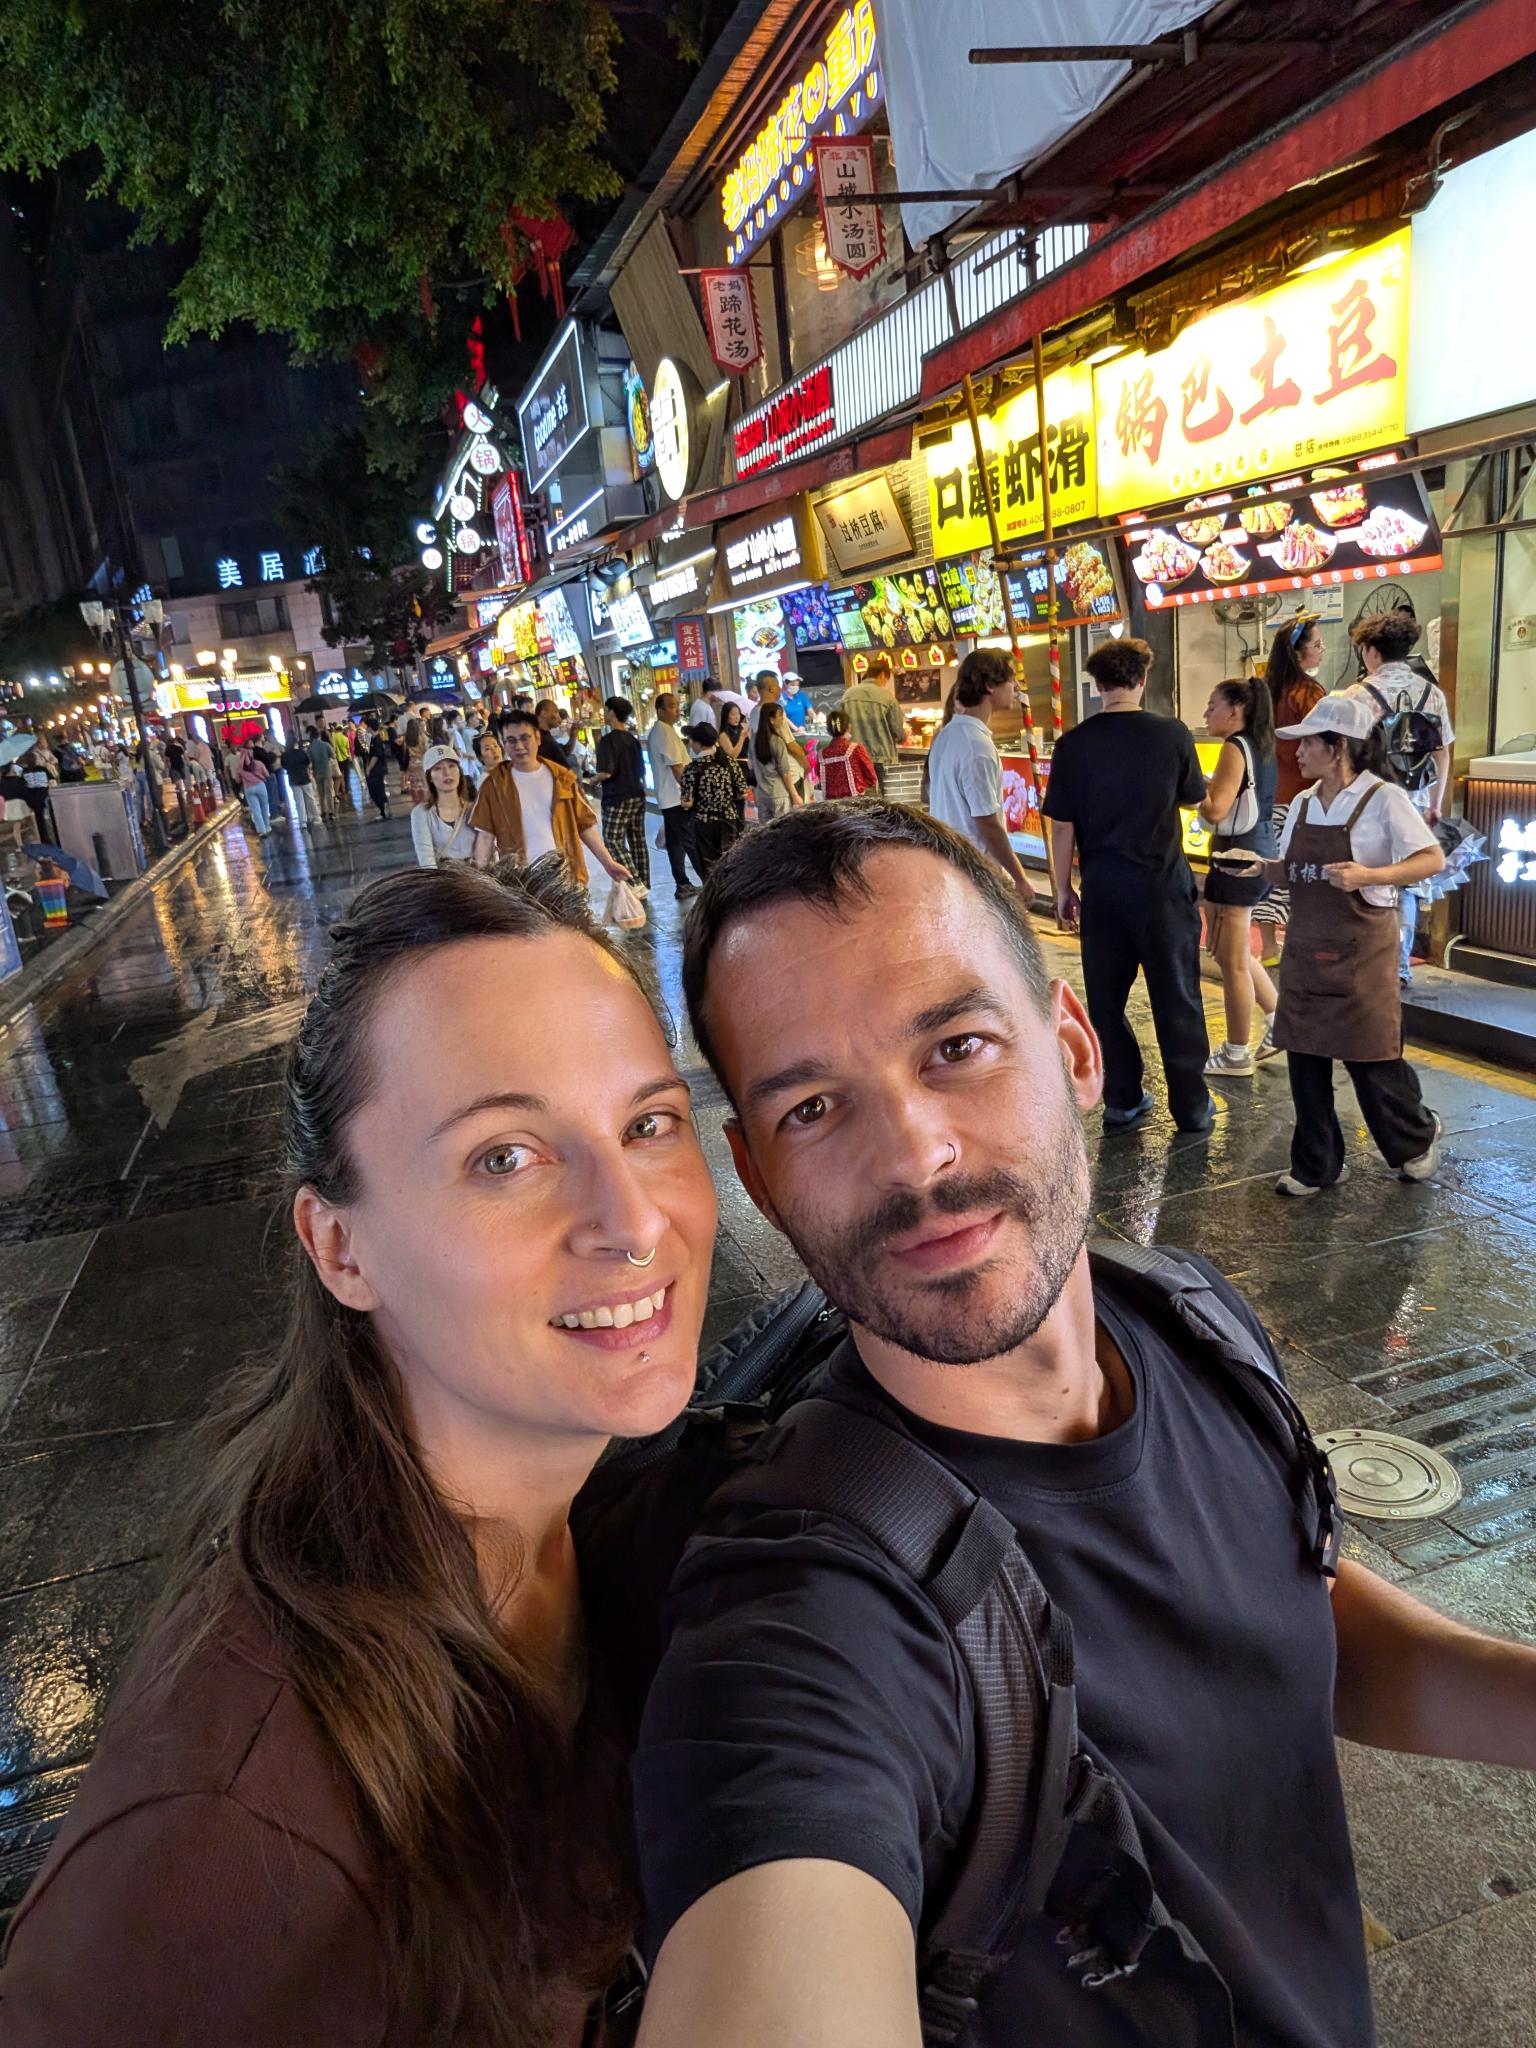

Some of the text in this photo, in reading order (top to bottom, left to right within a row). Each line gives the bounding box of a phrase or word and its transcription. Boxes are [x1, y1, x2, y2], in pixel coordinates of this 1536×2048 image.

[836, 163, 867, 260] 山城小汤圆
[713, 280, 741, 292] 老妈
[719, 294, 749, 359] 蹄花汤
[1115, 278, 1398, 467] 锅巴土豆
[934, 412, 1090, 530] 口蘑虾滑
[456, 502, 477, 551] 火锅
[681, 624, 698, 668] 重庆小面
